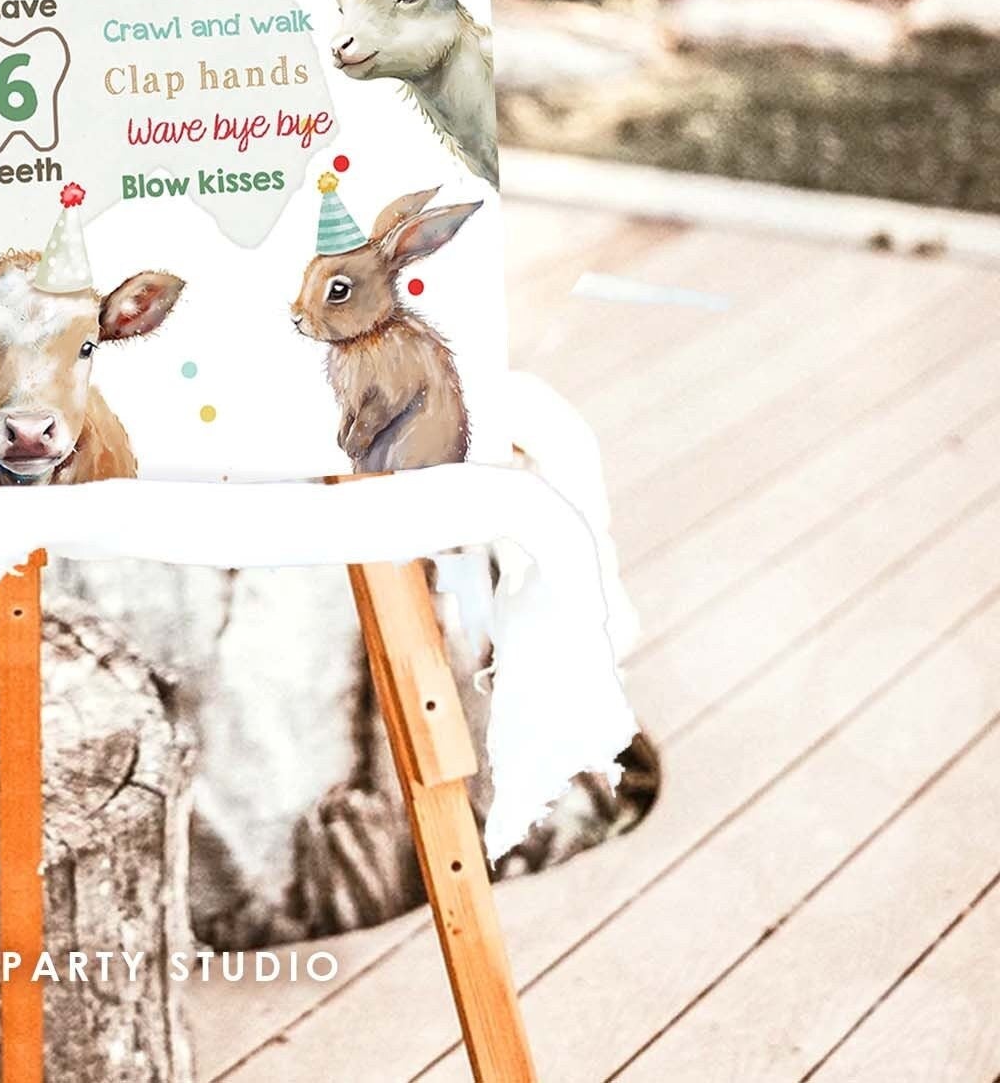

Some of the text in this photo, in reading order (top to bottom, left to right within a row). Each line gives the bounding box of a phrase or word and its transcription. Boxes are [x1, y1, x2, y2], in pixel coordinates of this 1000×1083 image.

[103, 10, 314, 43] Crawl and walk
[104, 55, 308, 101] Clap hands
[127, 109, 334, 153] Wave bye bye
[121, 167, 285, 200] Blow kisses
